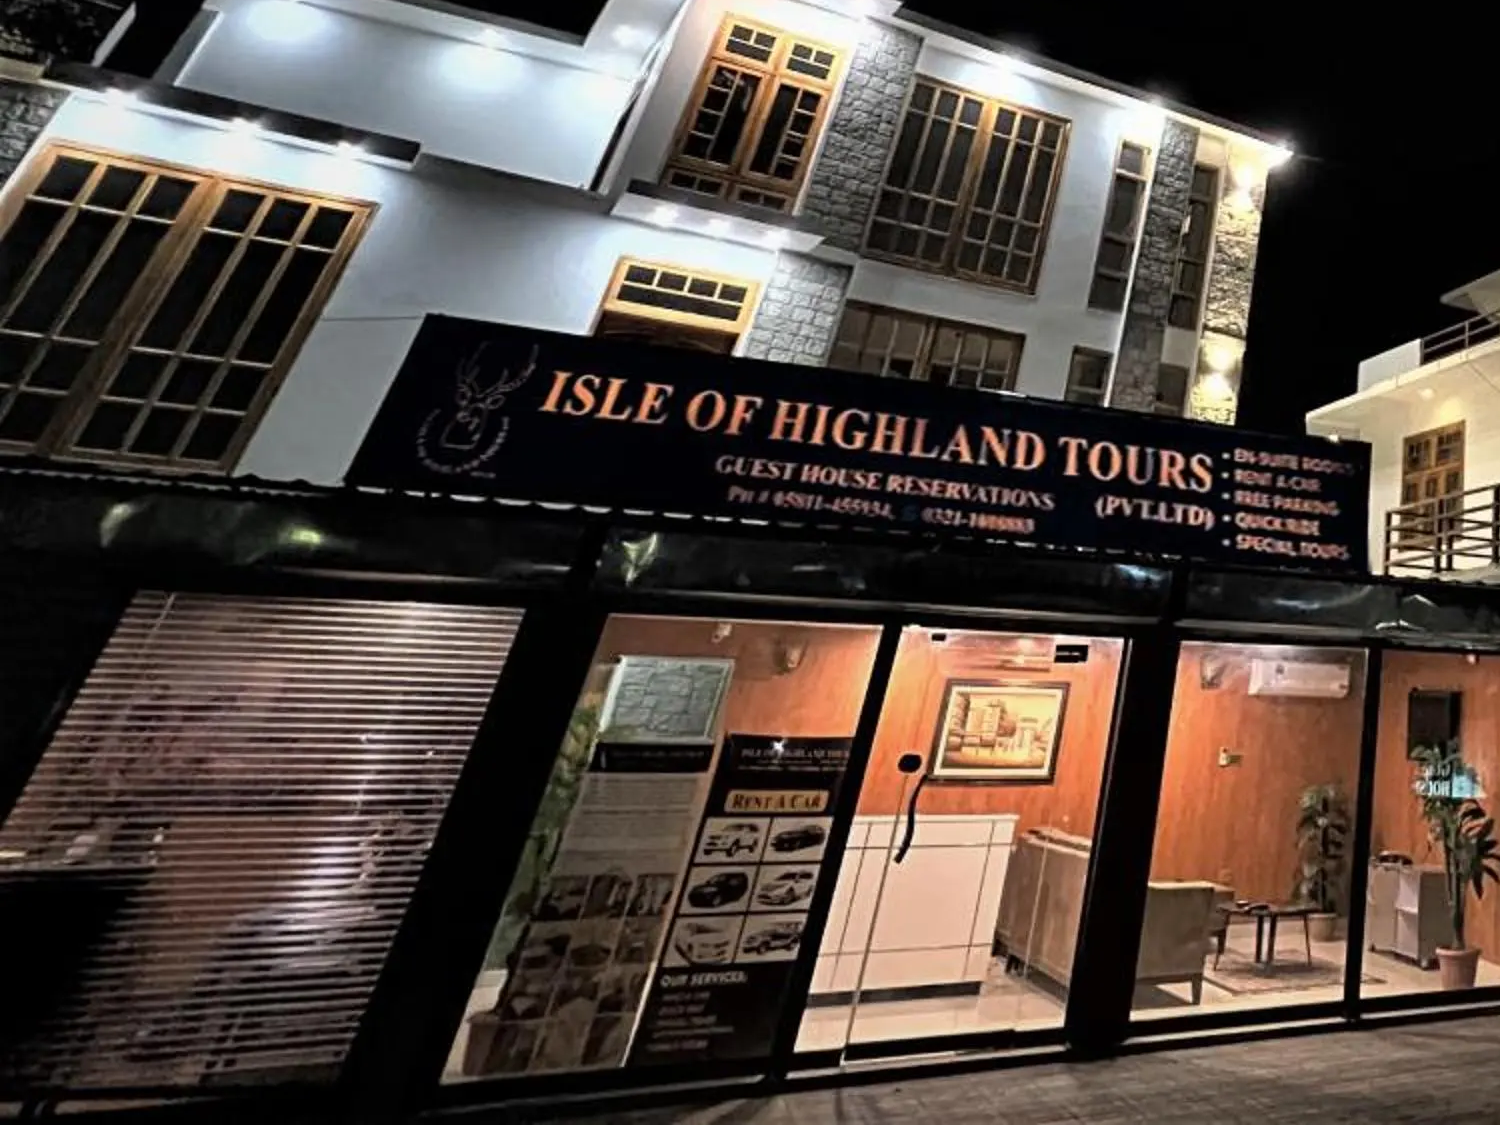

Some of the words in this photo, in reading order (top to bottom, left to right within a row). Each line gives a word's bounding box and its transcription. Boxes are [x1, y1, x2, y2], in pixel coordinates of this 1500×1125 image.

[538, 370, 675, 424] ISLE
[685, 389, 763, 436] OF
[768, 399, 1046, 471] HIGHLAND
[1058, 436, 1214, 493] TOURS
[715, 454, 798, 481] GUEST
[800, 463, 883, 491] HOUSE
[885, 475, 1057, 511] RESERVATIONS
